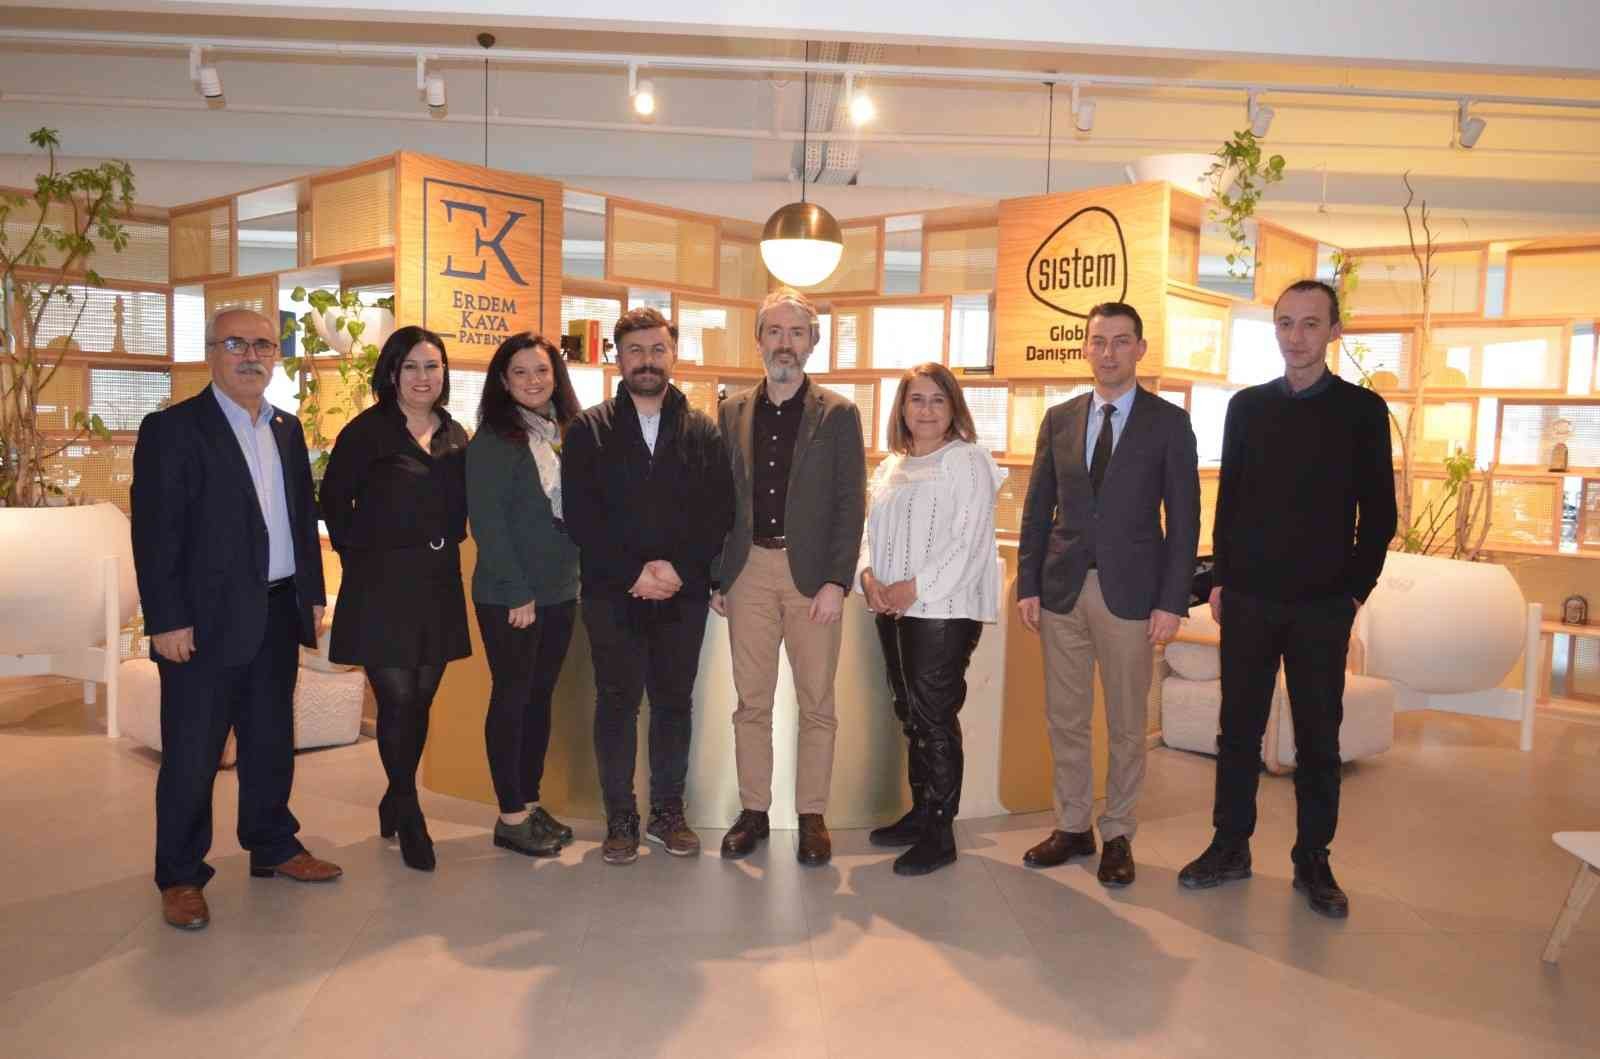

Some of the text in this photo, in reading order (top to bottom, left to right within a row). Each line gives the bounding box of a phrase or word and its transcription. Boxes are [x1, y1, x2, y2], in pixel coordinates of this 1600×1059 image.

[453, 290, 517, 314] ERDEM
[461, 310, 509, 332] KAYA
[1050, 325, 1088, 341] Glob
